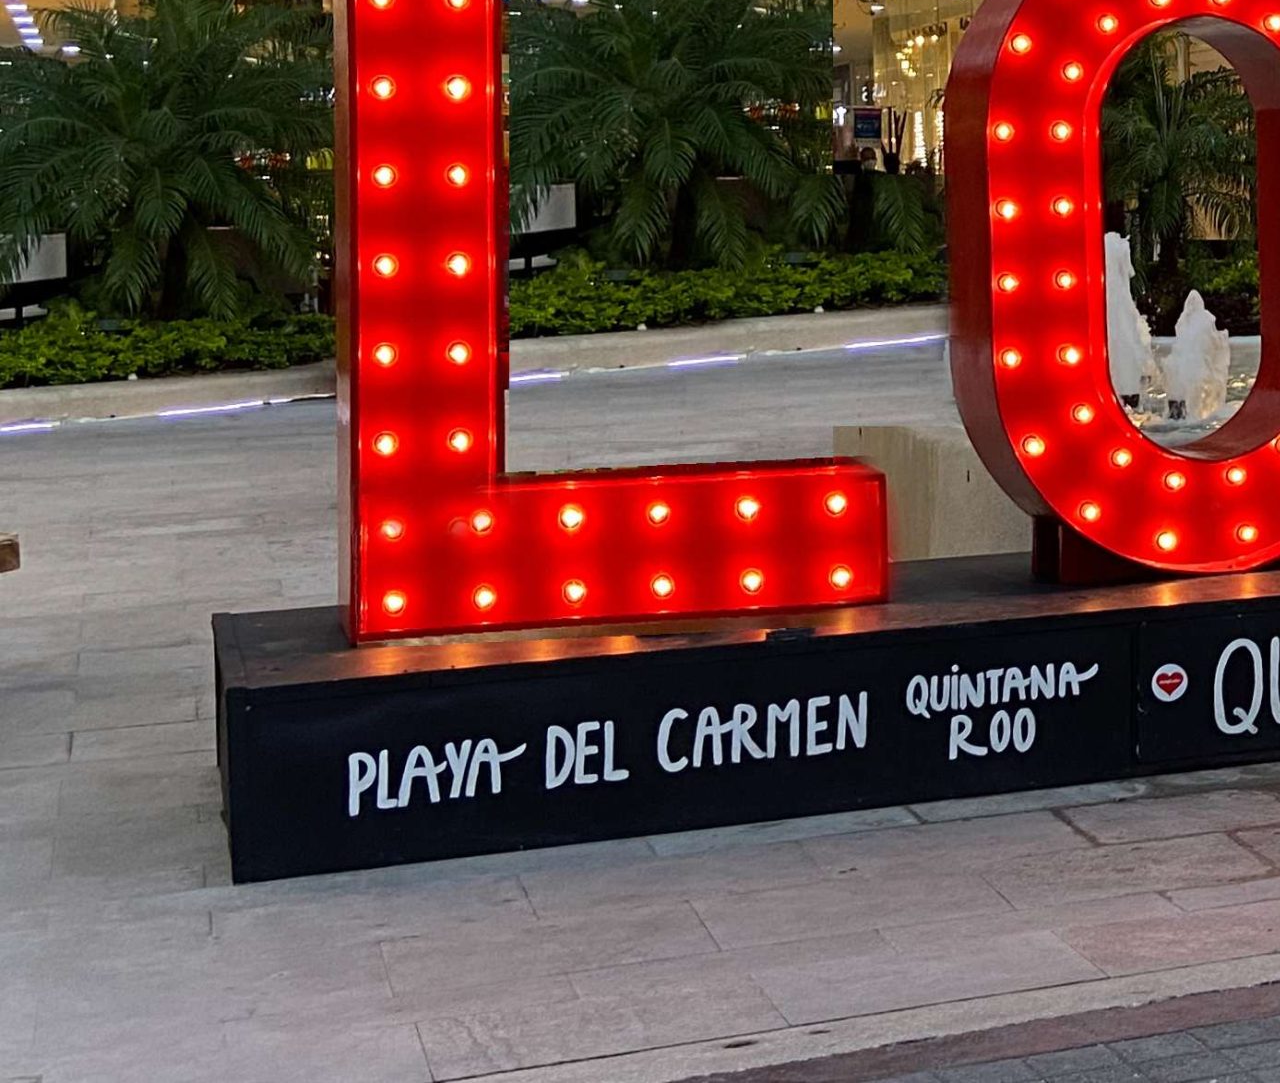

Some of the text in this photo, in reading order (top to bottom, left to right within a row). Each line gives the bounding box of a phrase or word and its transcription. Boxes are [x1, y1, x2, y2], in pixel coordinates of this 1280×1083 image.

[348, 691, 868, 817] PLAYA DEL CARMEN
